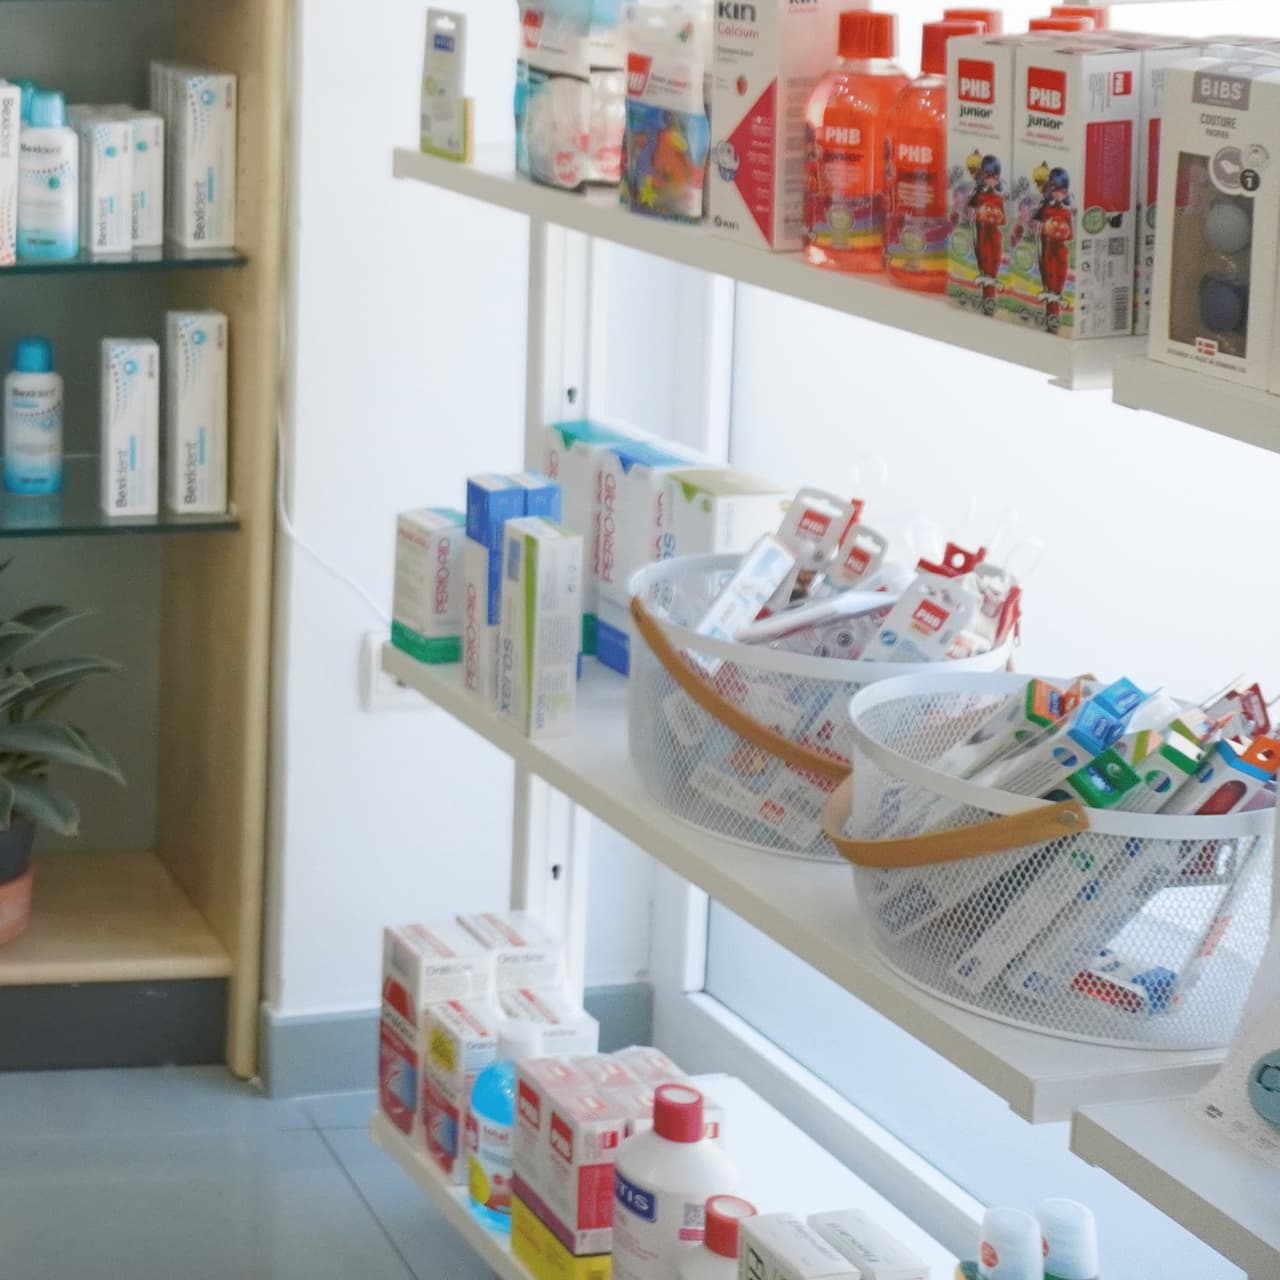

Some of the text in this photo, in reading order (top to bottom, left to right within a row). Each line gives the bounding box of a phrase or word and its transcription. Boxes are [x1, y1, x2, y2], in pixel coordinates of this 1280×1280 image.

[718, 22, 760, 40] Calcium
[959, 76, 991, 99] PHB
[1029, 86, 1062, 109] PHB
[1200, 78, 1242, 100] BIBS
[959, 103, 993, 119] junior
[1200, 113, 1237, 130] COUTURE
[1027, 113, 1064, 131] junior
[825, 126, 861, 146] PHB
[898, 144, 933, 164] PHB
[116, 449, 128, 508] Bexident
[184, 441, 197, 505] Bexident
[618, 1180, 650, 1212] TIS
